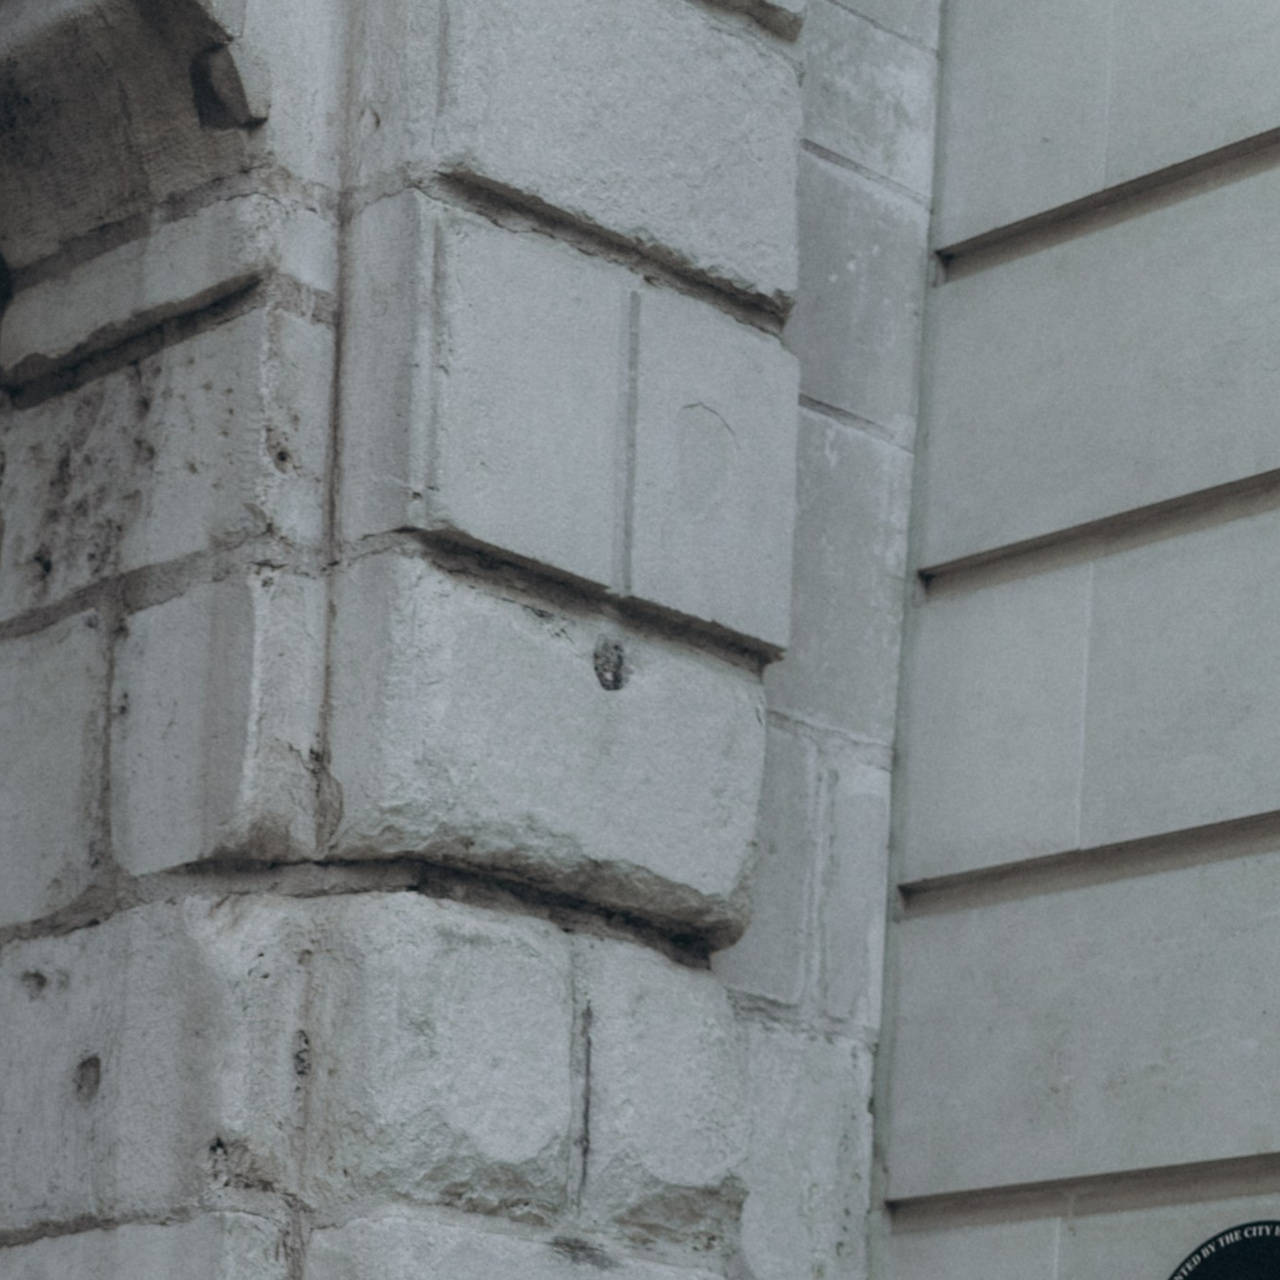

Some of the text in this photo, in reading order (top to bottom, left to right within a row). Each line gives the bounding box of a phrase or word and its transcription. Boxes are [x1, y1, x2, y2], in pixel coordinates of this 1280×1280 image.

[1201, 1241, 1216, 1258] BY
[1219, 1230, 1241, 1247] THE
[1244, 1225, 1273, 1238] CITY
